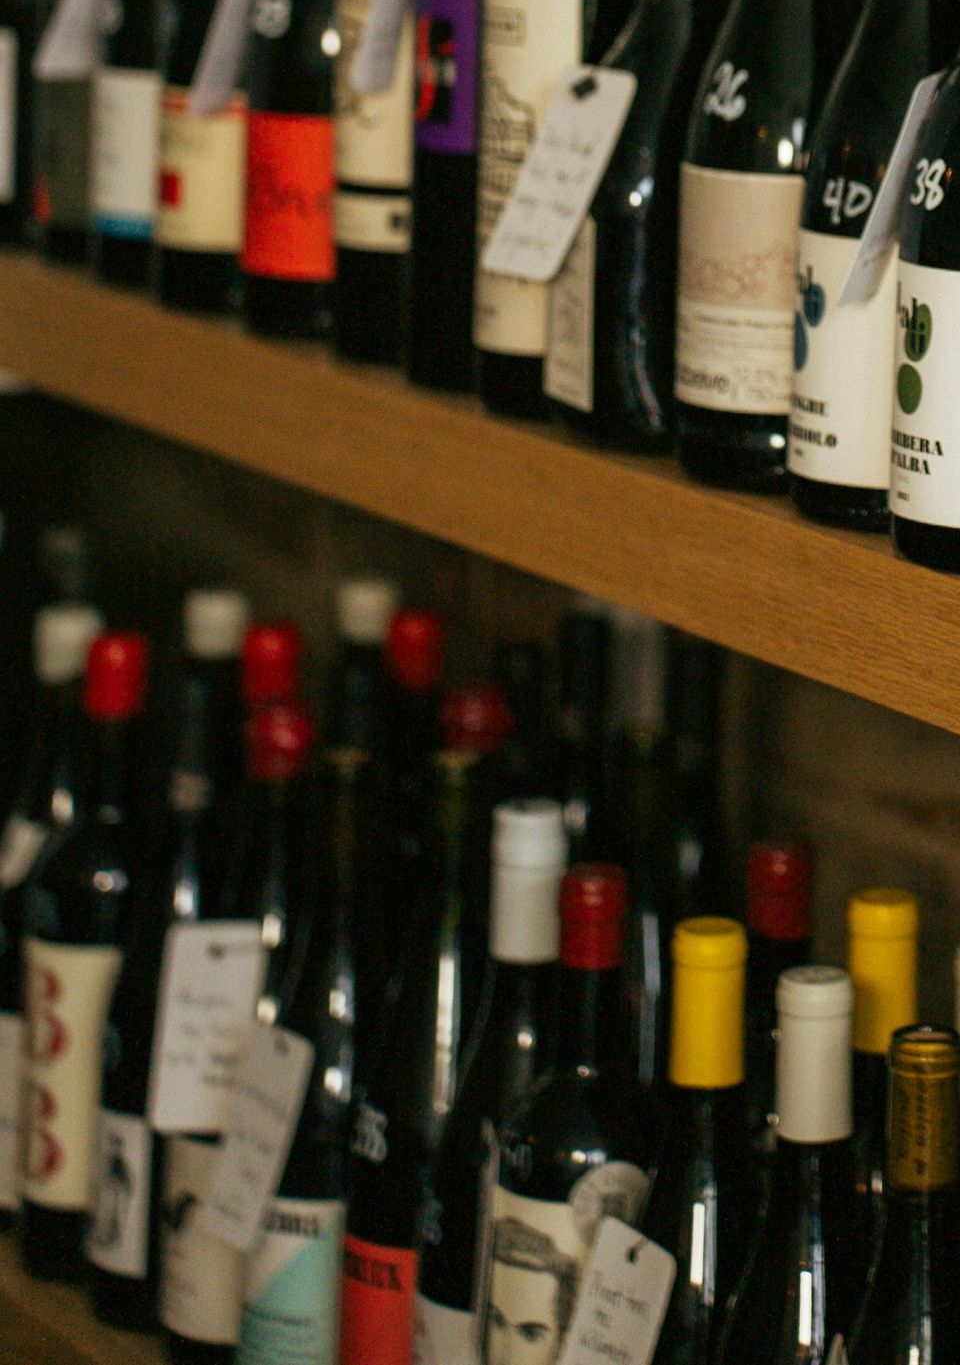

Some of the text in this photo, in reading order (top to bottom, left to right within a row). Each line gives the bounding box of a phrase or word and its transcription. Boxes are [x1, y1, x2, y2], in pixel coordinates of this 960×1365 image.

[704, 61, 749, 122] 26
[824, 177, 873, 225] 40
[910, 158, 946, 211] 38
